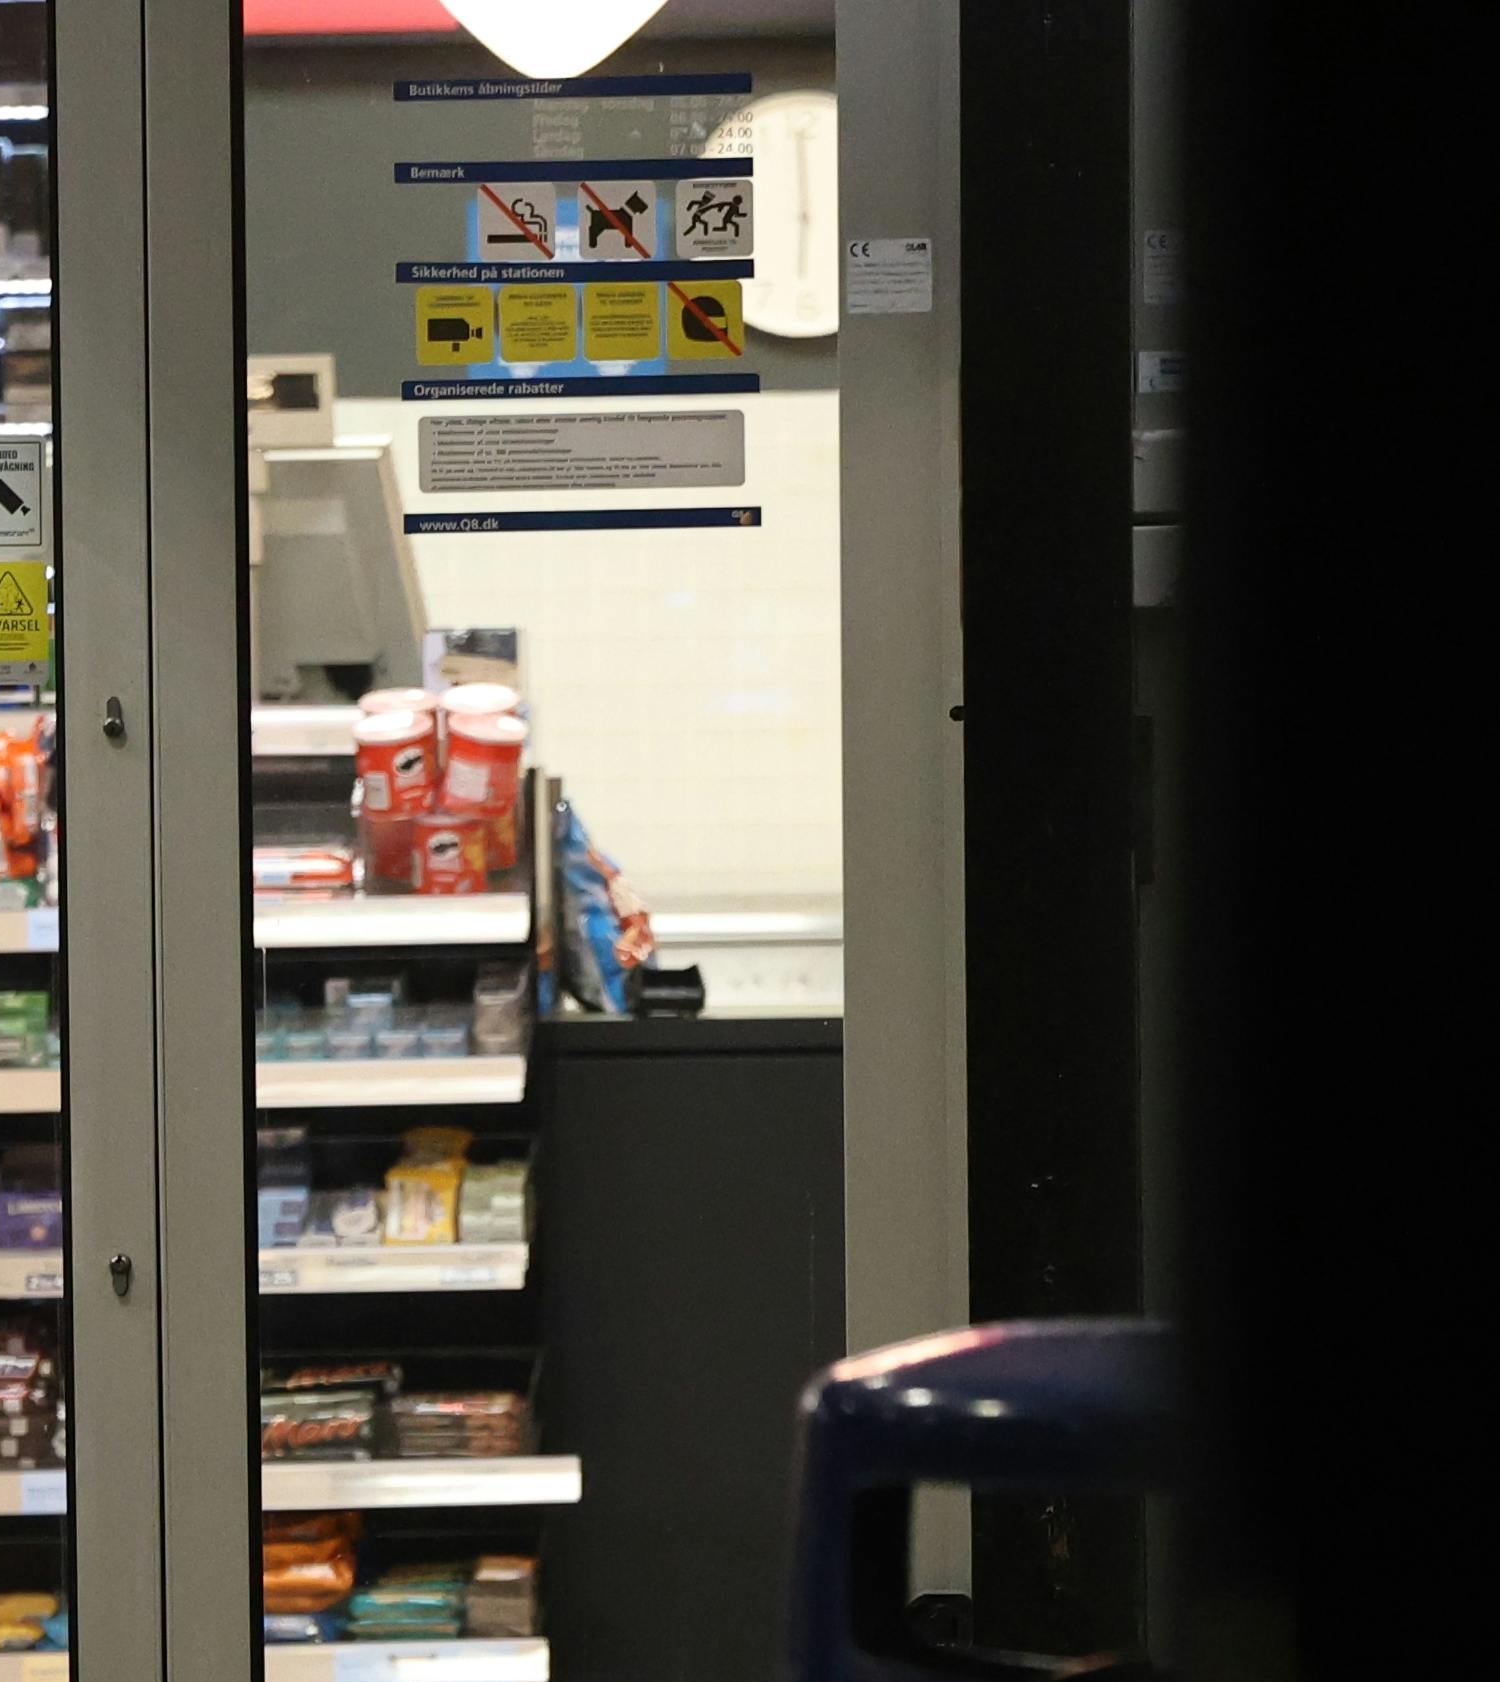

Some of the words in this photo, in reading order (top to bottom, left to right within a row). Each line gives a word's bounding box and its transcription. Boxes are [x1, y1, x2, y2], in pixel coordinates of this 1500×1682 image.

[408, 83, 475, 97] Butikkens
[478, 81, 563, 97] åbningstider
[410, 166, 465, 179] Bemærk
[411, 264, 477, 279] Sikkerhed
[481, 266, 498, 282] på
[501, 265, 565, 279] stationen
[413, 382, 505, 399] Organiserede
[508, 381, 564, 395] rabatter
[419, 517, 500, 533] www.Q8.dk
